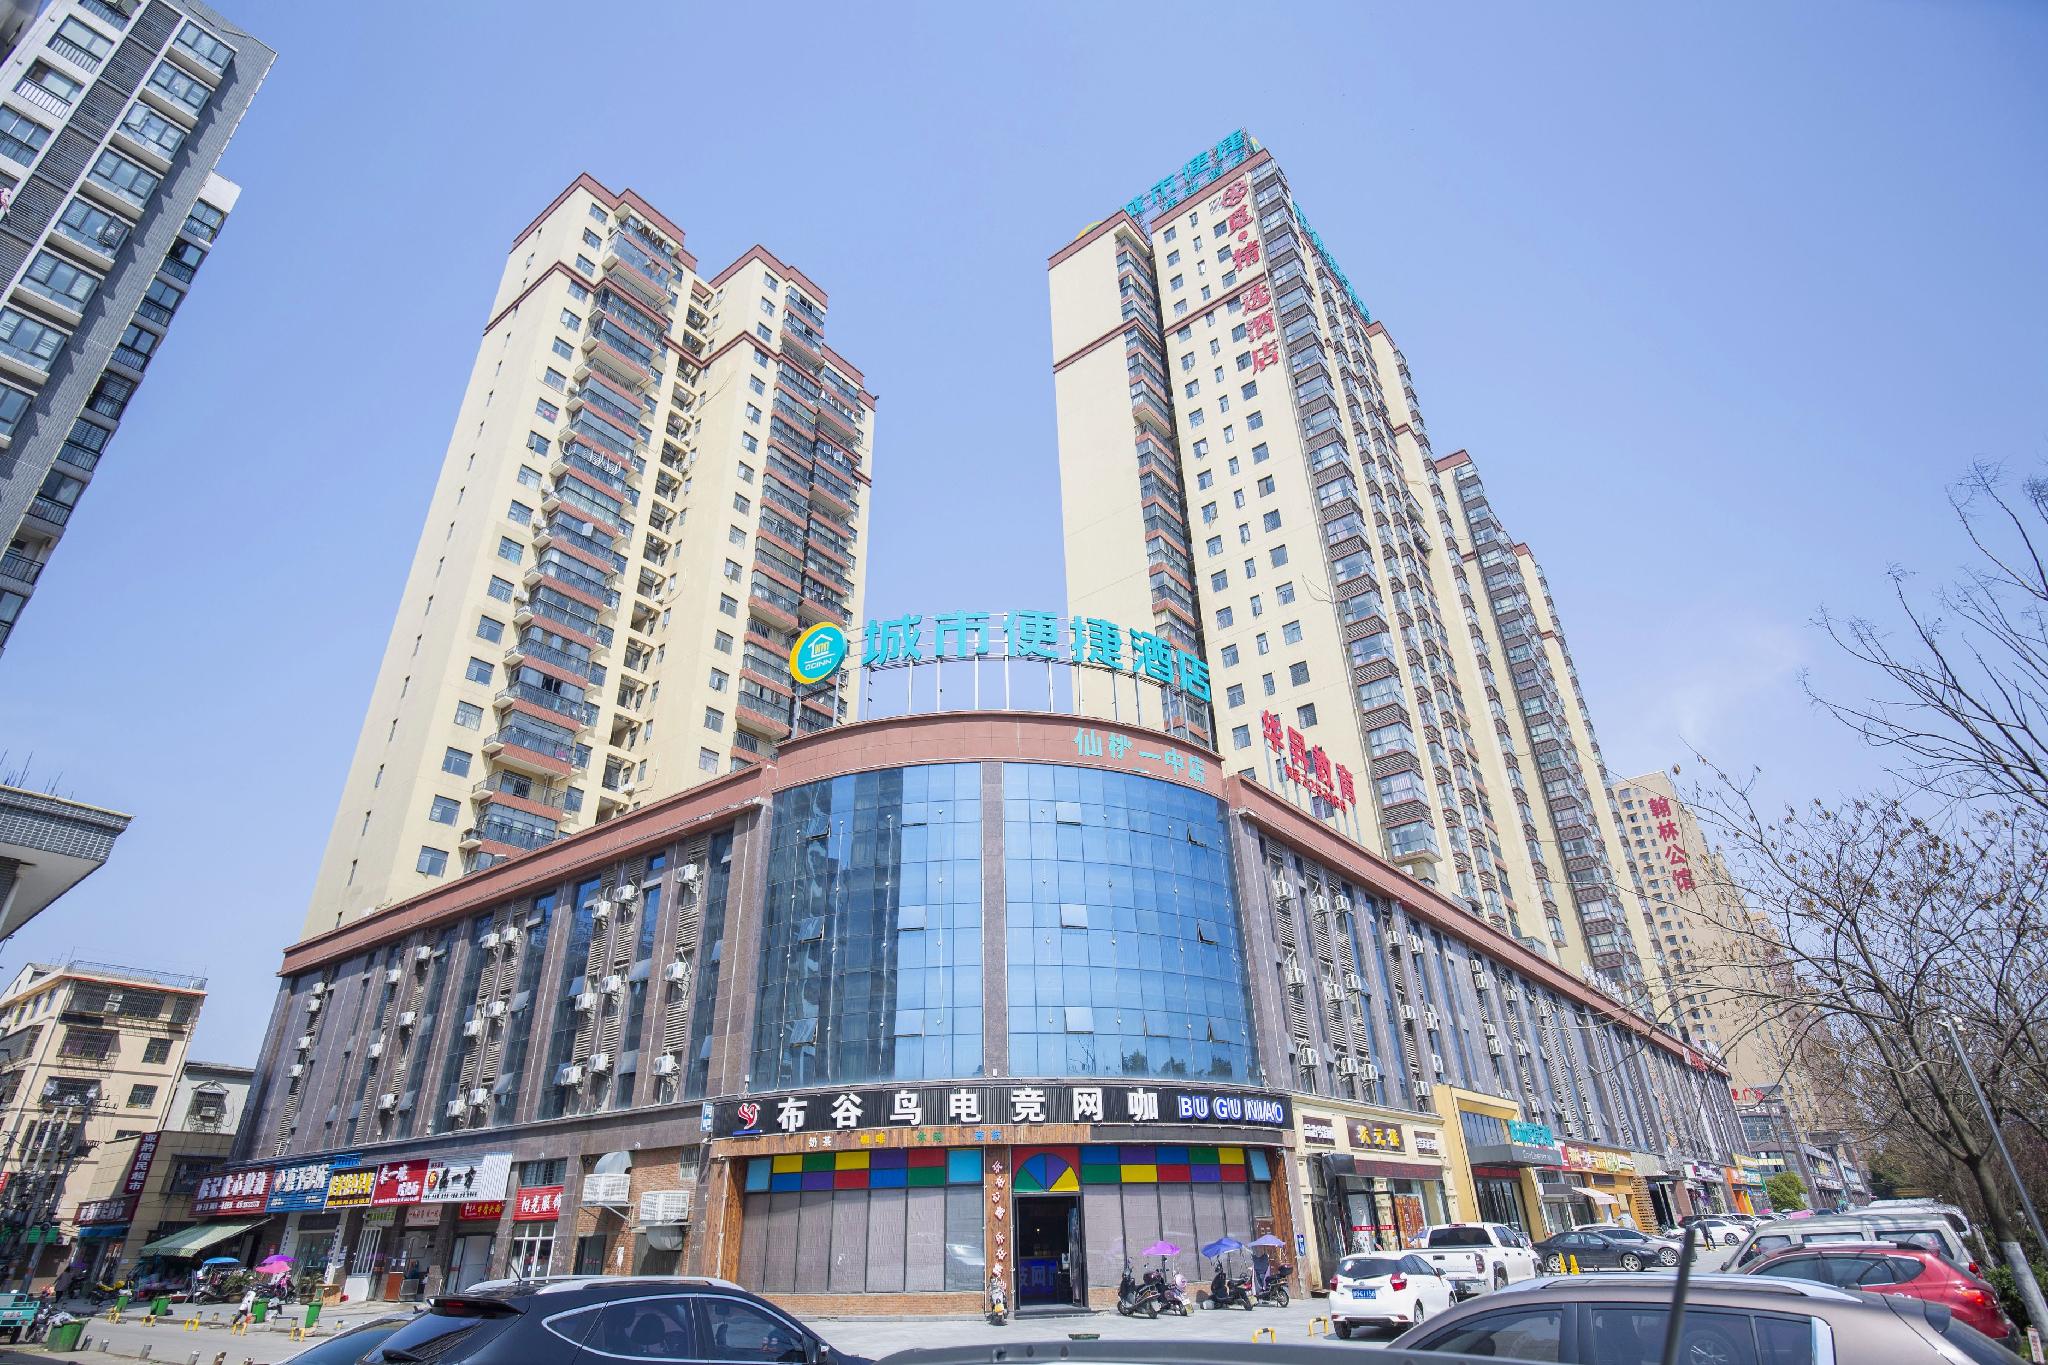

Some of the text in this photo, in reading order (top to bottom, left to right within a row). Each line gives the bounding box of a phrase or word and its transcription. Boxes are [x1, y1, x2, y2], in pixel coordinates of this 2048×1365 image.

[862, 610, 1212, 702] 城市便捷酒店
[776, 1086, 1159, 1133] 布谷鸟电竞网咖
[1177, 1095, 1208, 1119] BU
[1212, 1096, 1241, 1119] GU
[808, 1135, 832, 1148] 奶茶
